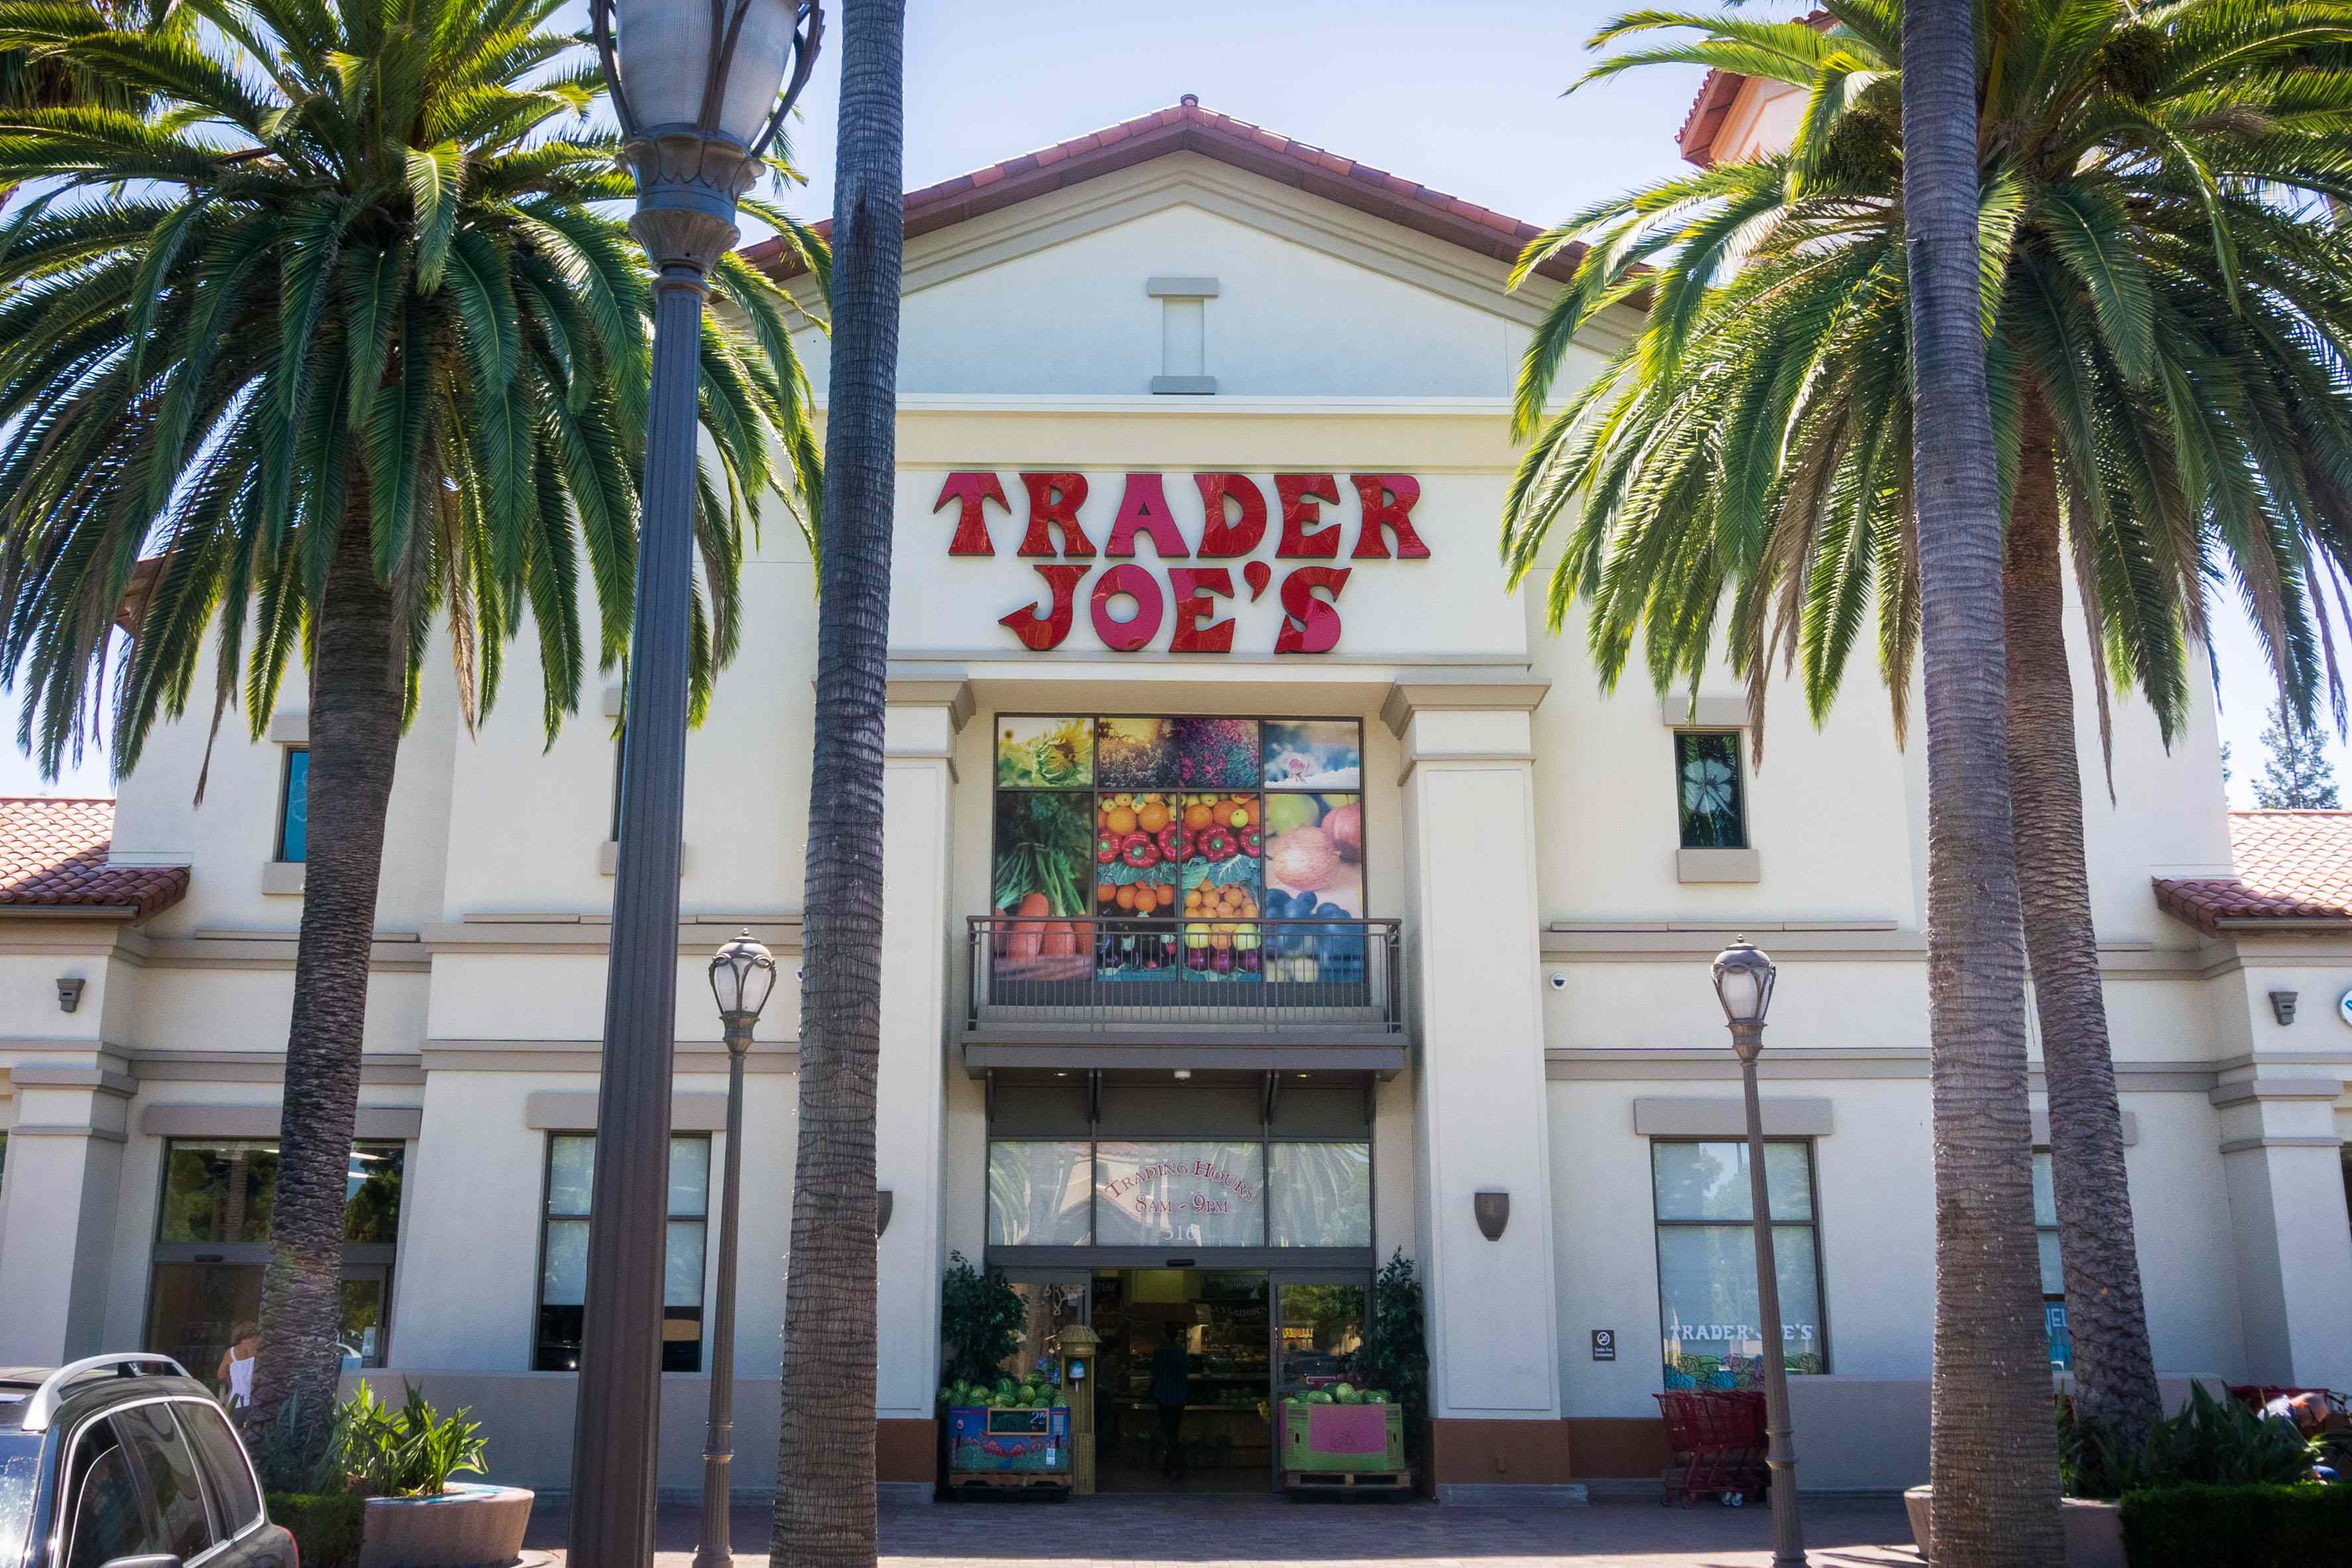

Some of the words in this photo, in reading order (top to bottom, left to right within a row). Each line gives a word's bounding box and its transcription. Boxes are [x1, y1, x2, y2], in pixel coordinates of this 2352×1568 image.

[933, 472, 1431, 559] TRADER
[997, 561, 1352, 654] JOE'S
[1105, 1161, 1188, 1199] TRADING
[1194, 1160, 1253, 1202] HOURS
[1135, 1194, 1172, 1213] 8AM
[1193, 1194, 1230, 1213] 9PM
[1669, 1325, 1750, 1340] TRADER
